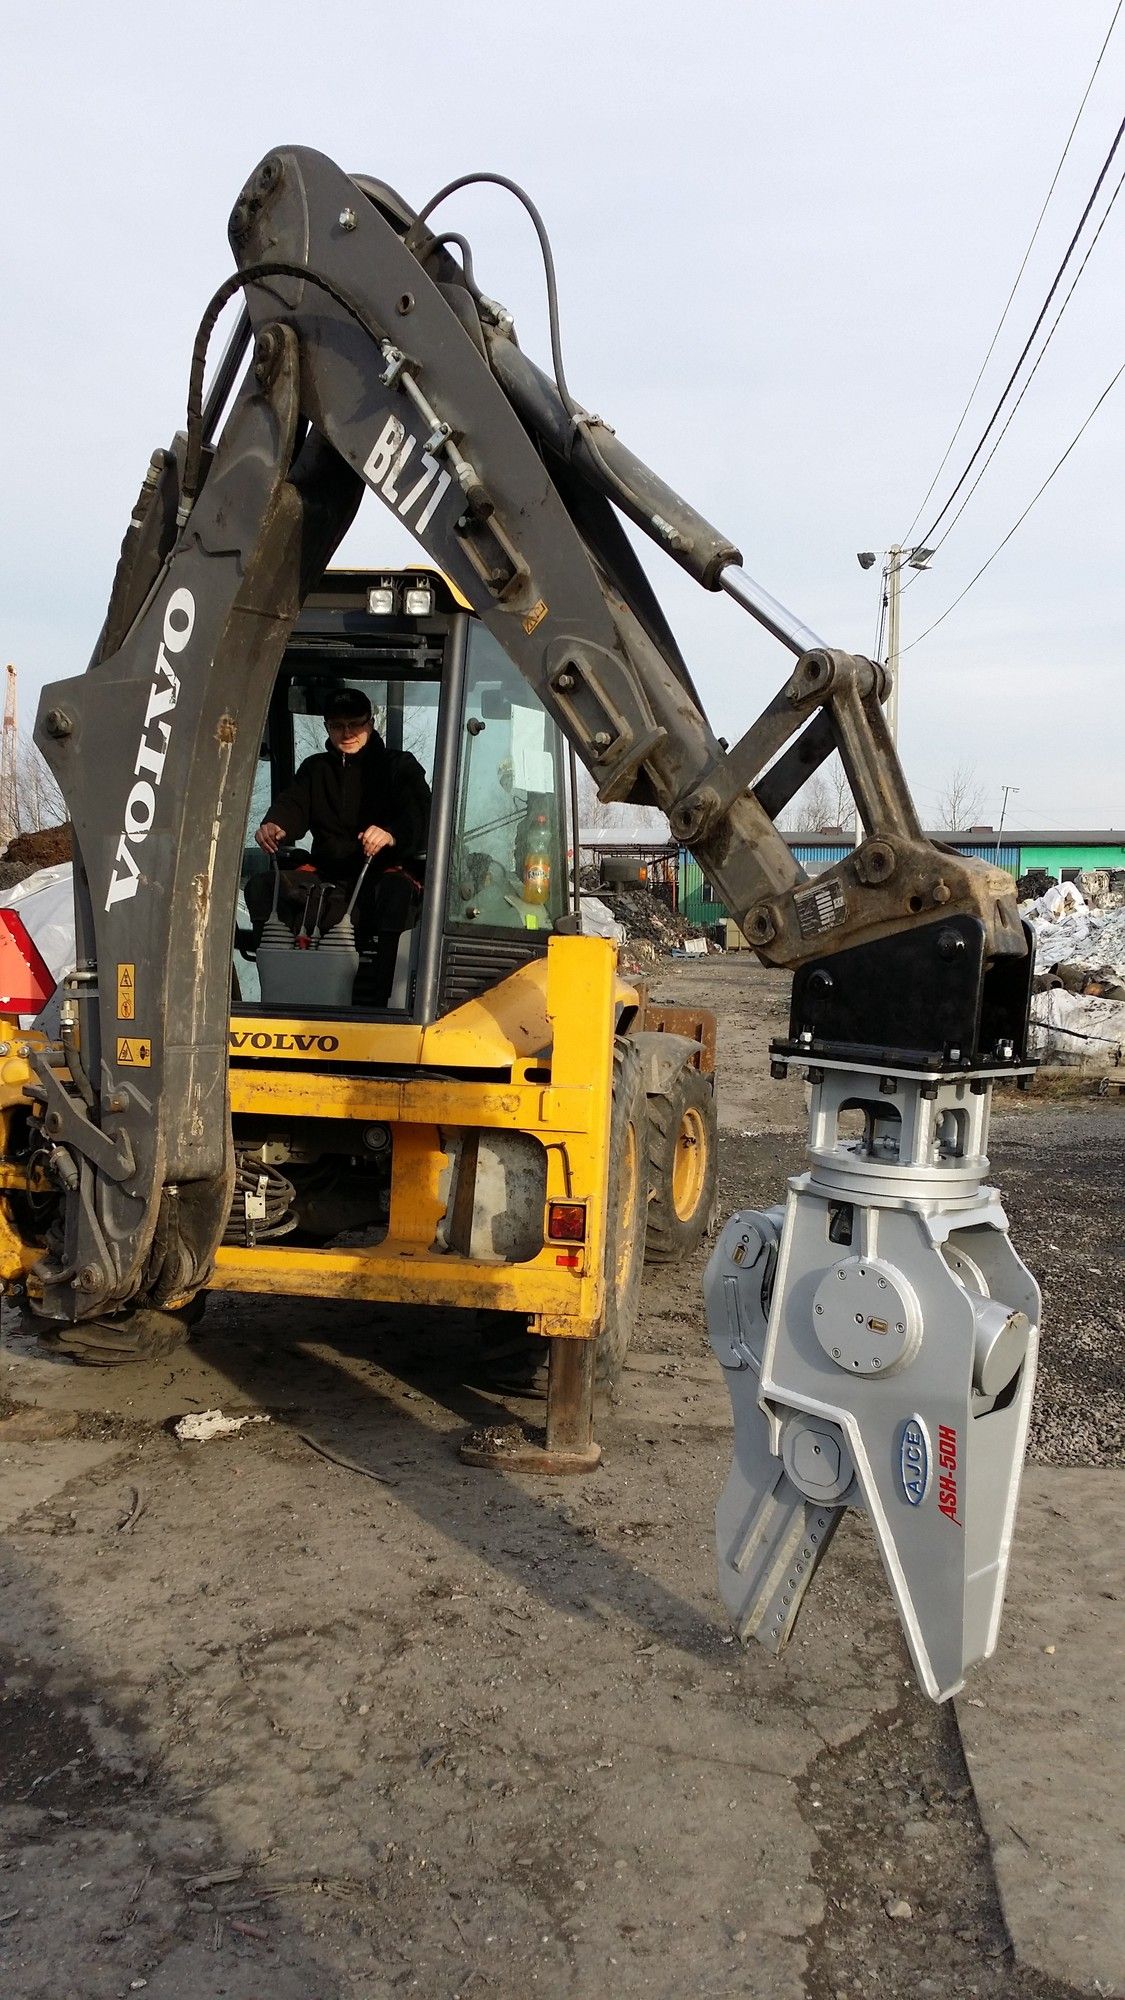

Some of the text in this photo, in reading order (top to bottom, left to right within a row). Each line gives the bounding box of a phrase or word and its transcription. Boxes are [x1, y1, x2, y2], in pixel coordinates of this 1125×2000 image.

[363, 415, 451, 534] BL71
[105, 588, 195, 912] VOLVO
[230, 1032, 339, 1052] VOLVO
[907, 1432, 922, 1494] AJCE
[938, 1425, 961, 1527] ASH-50H
